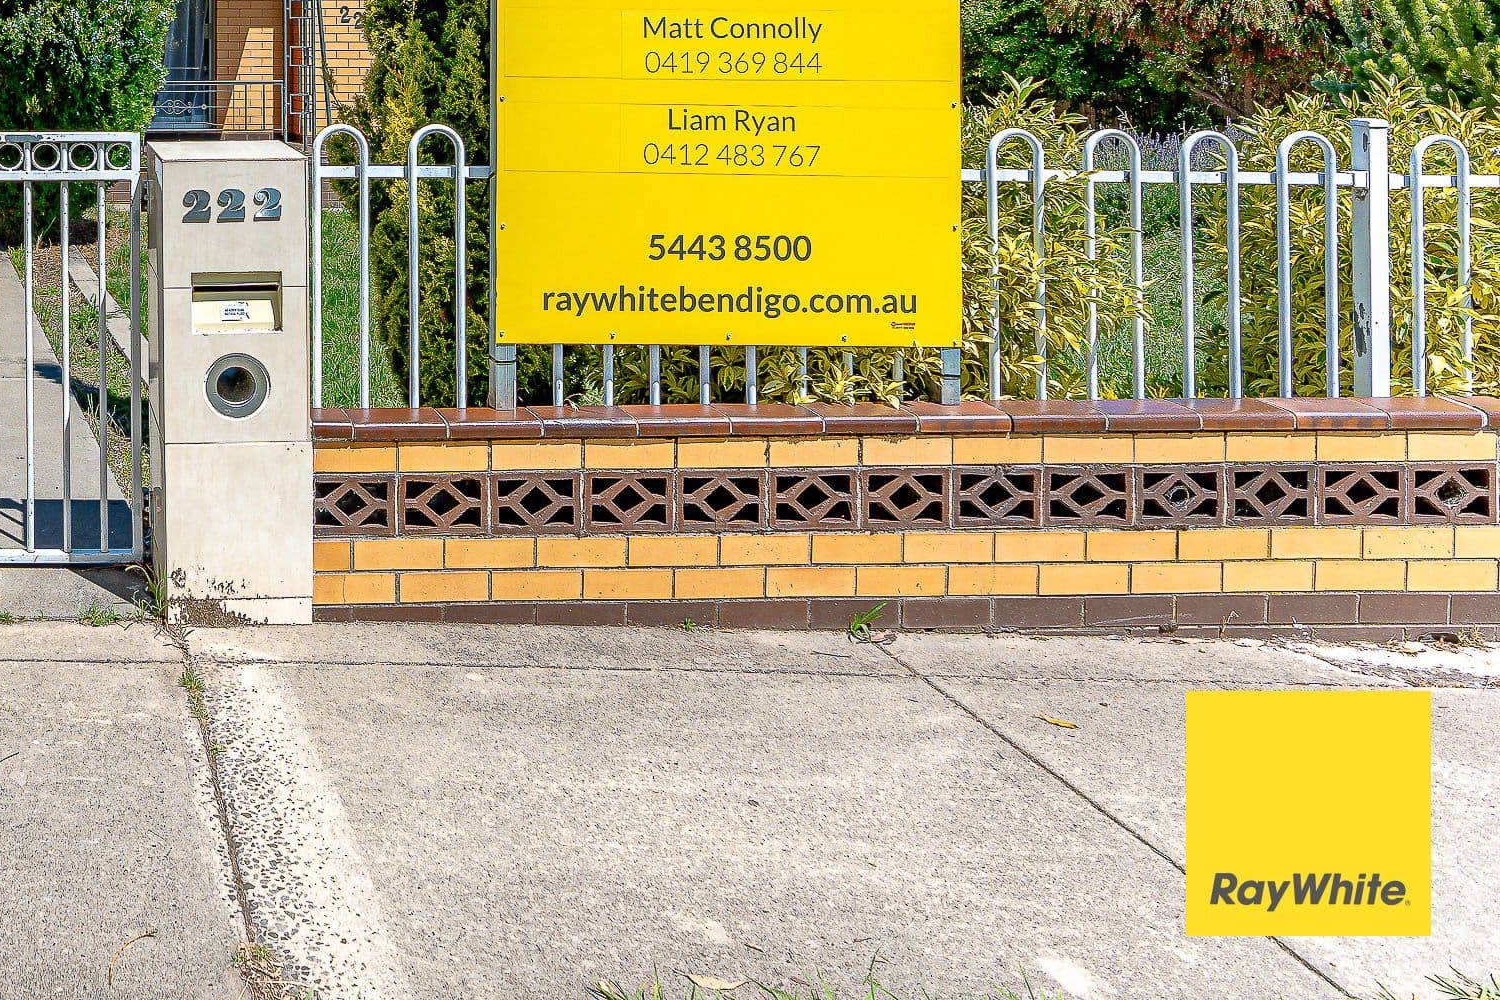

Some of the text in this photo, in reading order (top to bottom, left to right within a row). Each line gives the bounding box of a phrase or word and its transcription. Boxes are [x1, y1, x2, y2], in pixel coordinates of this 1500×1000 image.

[339, 5, 364, 29] 22
[643, 16, 823, 44] Matt Connolly
[645, 51, 823, 74] 0419 369 844
[668, 108, 796, 137] Liam Ryan
[643, 143, 821, 168] 0412 483 767
[181, 187, 283, 224] 222
[648, 234, 812, 262] 5443 8500
[543, 285, 917, 319] raywhitebendigo.com.au
